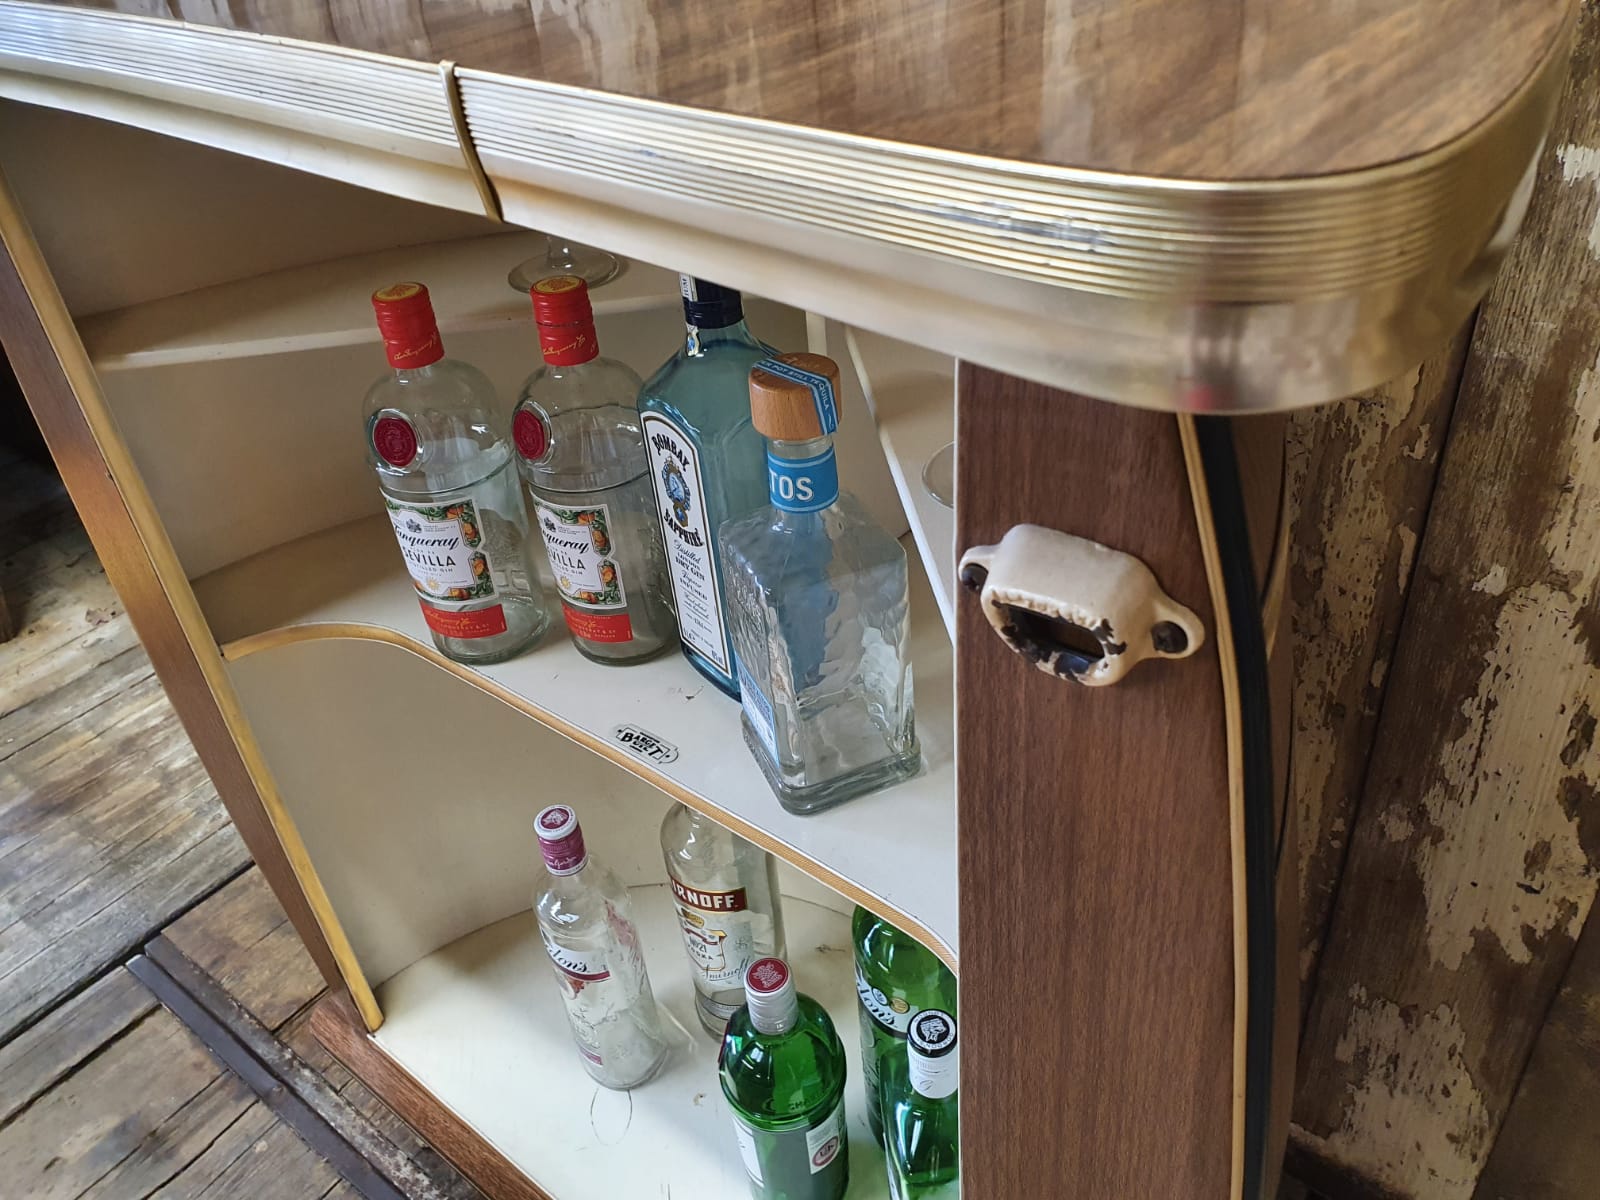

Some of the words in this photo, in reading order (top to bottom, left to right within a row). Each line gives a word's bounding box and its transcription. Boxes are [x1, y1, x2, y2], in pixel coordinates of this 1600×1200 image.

[652, 433, 690, 472] BOMBAY
[770, 470, 814, 501] TOS
[394, 524, 460, 551] Tanqueray
[664, 508, 705, 547] SAPPHIRE
[672, 880, 735, 909] IRNOFF
